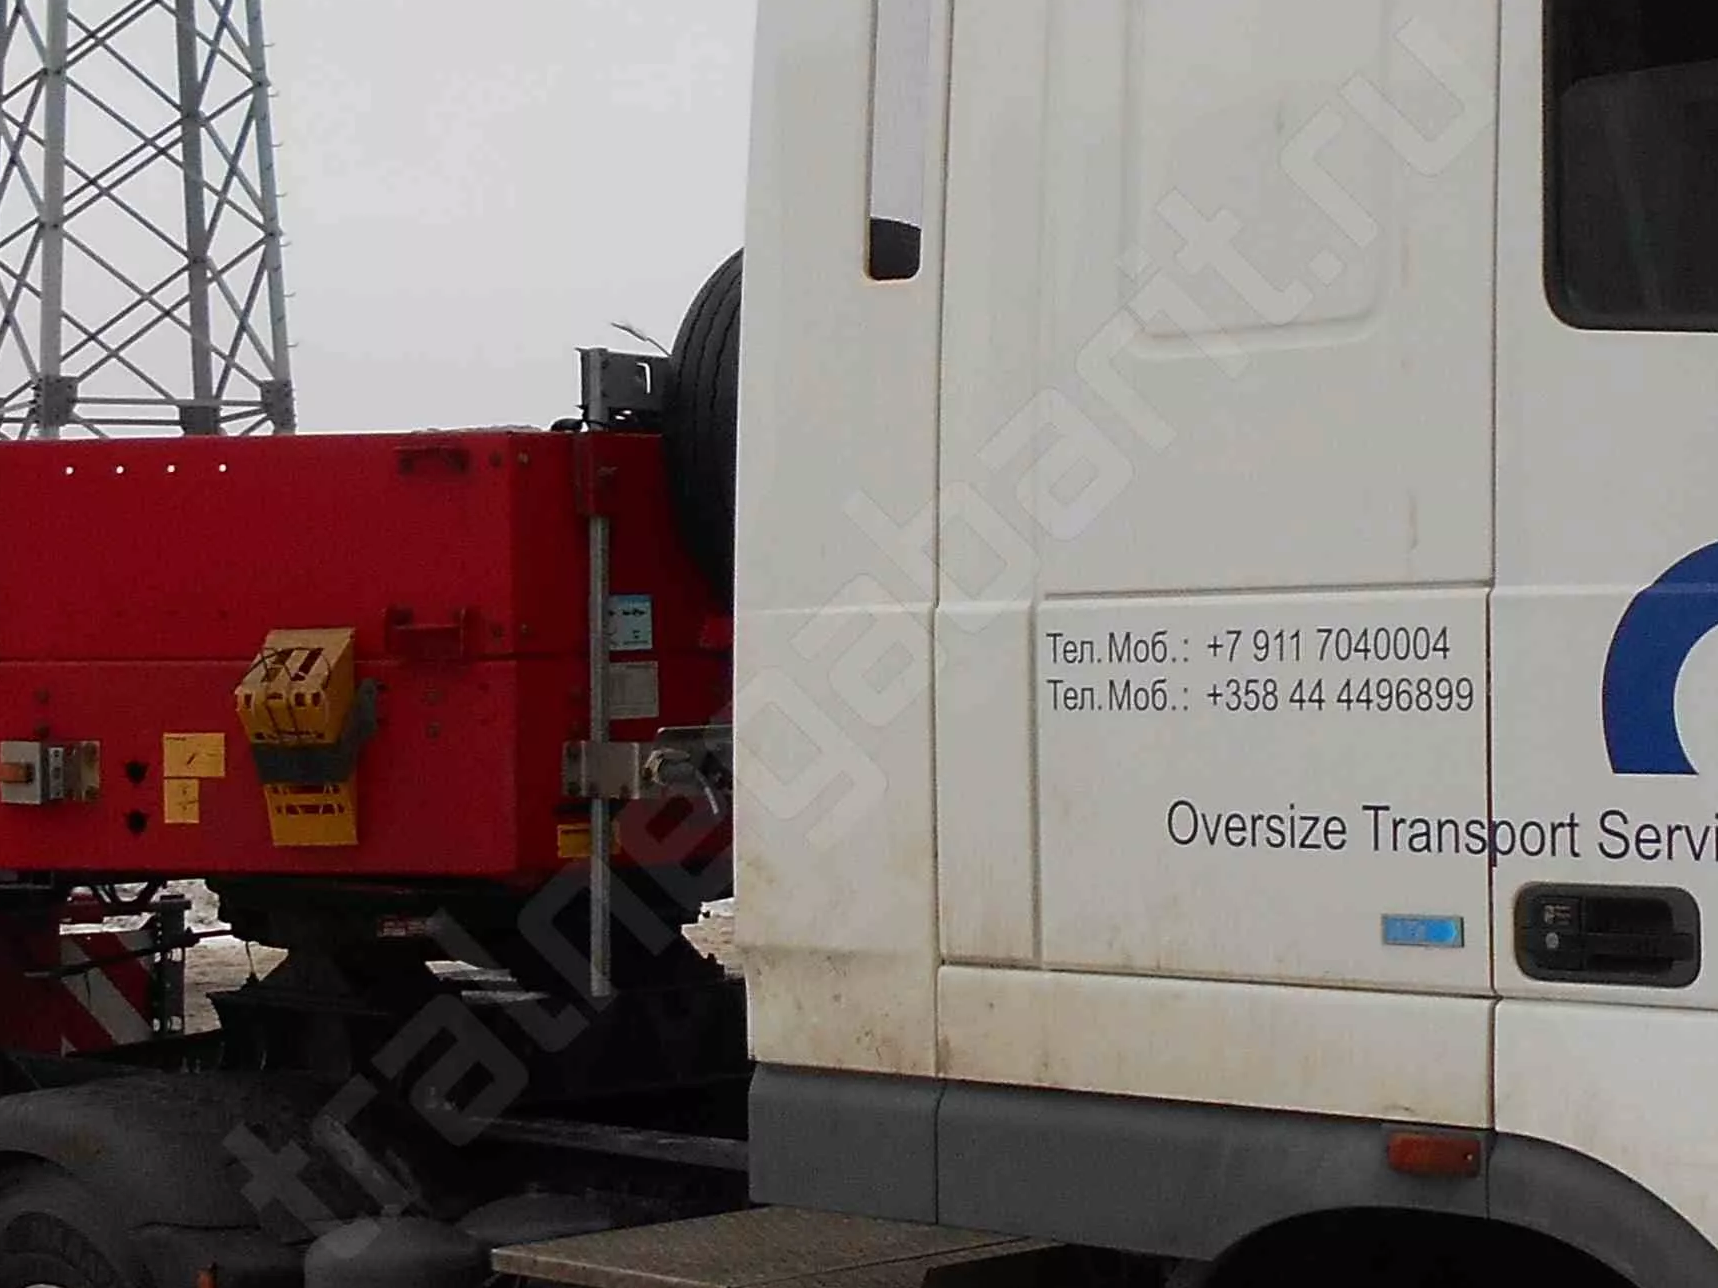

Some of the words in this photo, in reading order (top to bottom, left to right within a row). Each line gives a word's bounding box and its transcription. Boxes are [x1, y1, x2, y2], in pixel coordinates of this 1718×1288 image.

[1207, 630, 1241, 662] +7
[1253, 629, 1302, 662] 911
[1316, 627, 1450, 662] 7040004
[1207, 679, 1278, 711] +358
[1289, 679, 1325, 711] 44
[1337, 678, 1473, 711] 4496899
[1167, 800, 1347, 850] Oversize
[1361, 804, 1580, 866] Transport
